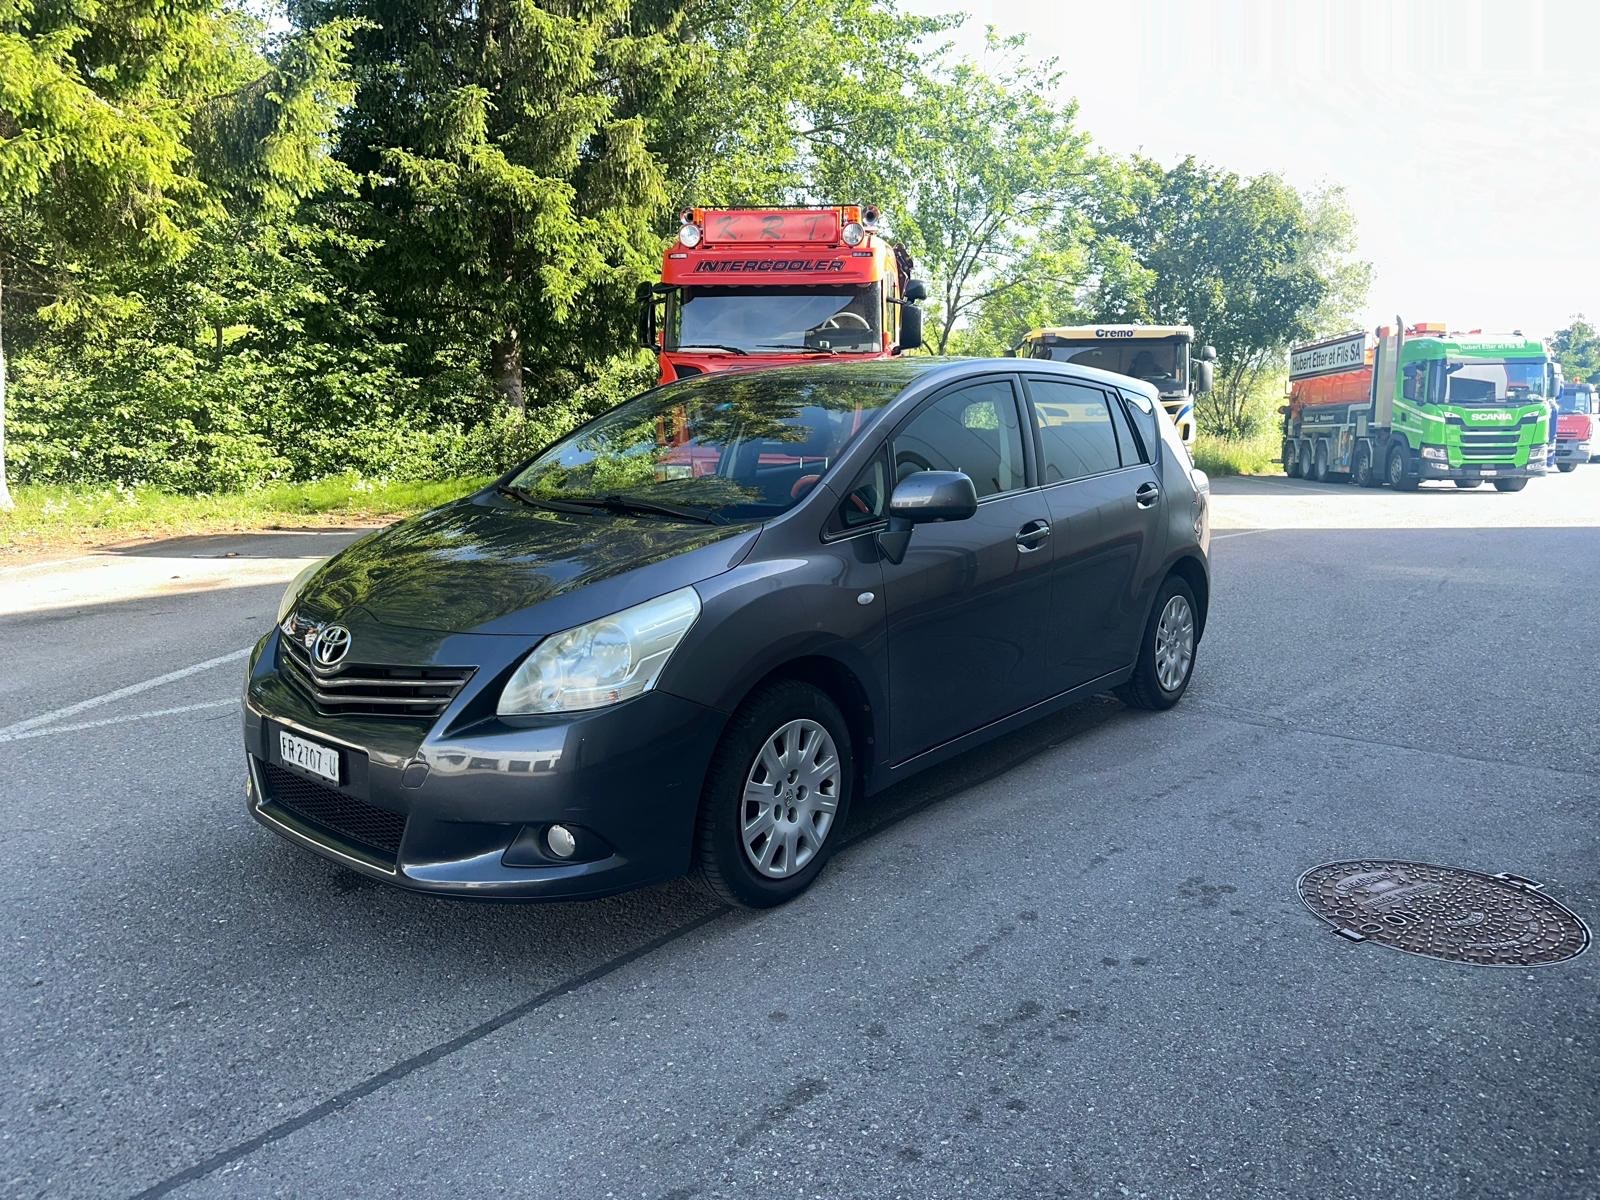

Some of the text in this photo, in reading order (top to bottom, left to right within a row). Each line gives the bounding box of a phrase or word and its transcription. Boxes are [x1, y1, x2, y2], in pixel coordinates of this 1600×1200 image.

[694, 259, 846, 272] INTERCOOLER
[1096, 328, 1133, 338] Cremo
[1292, 341, 1361, 371] Hubert Etter et Fils SA
[1471, 413, 1513, 421] SCANIA
